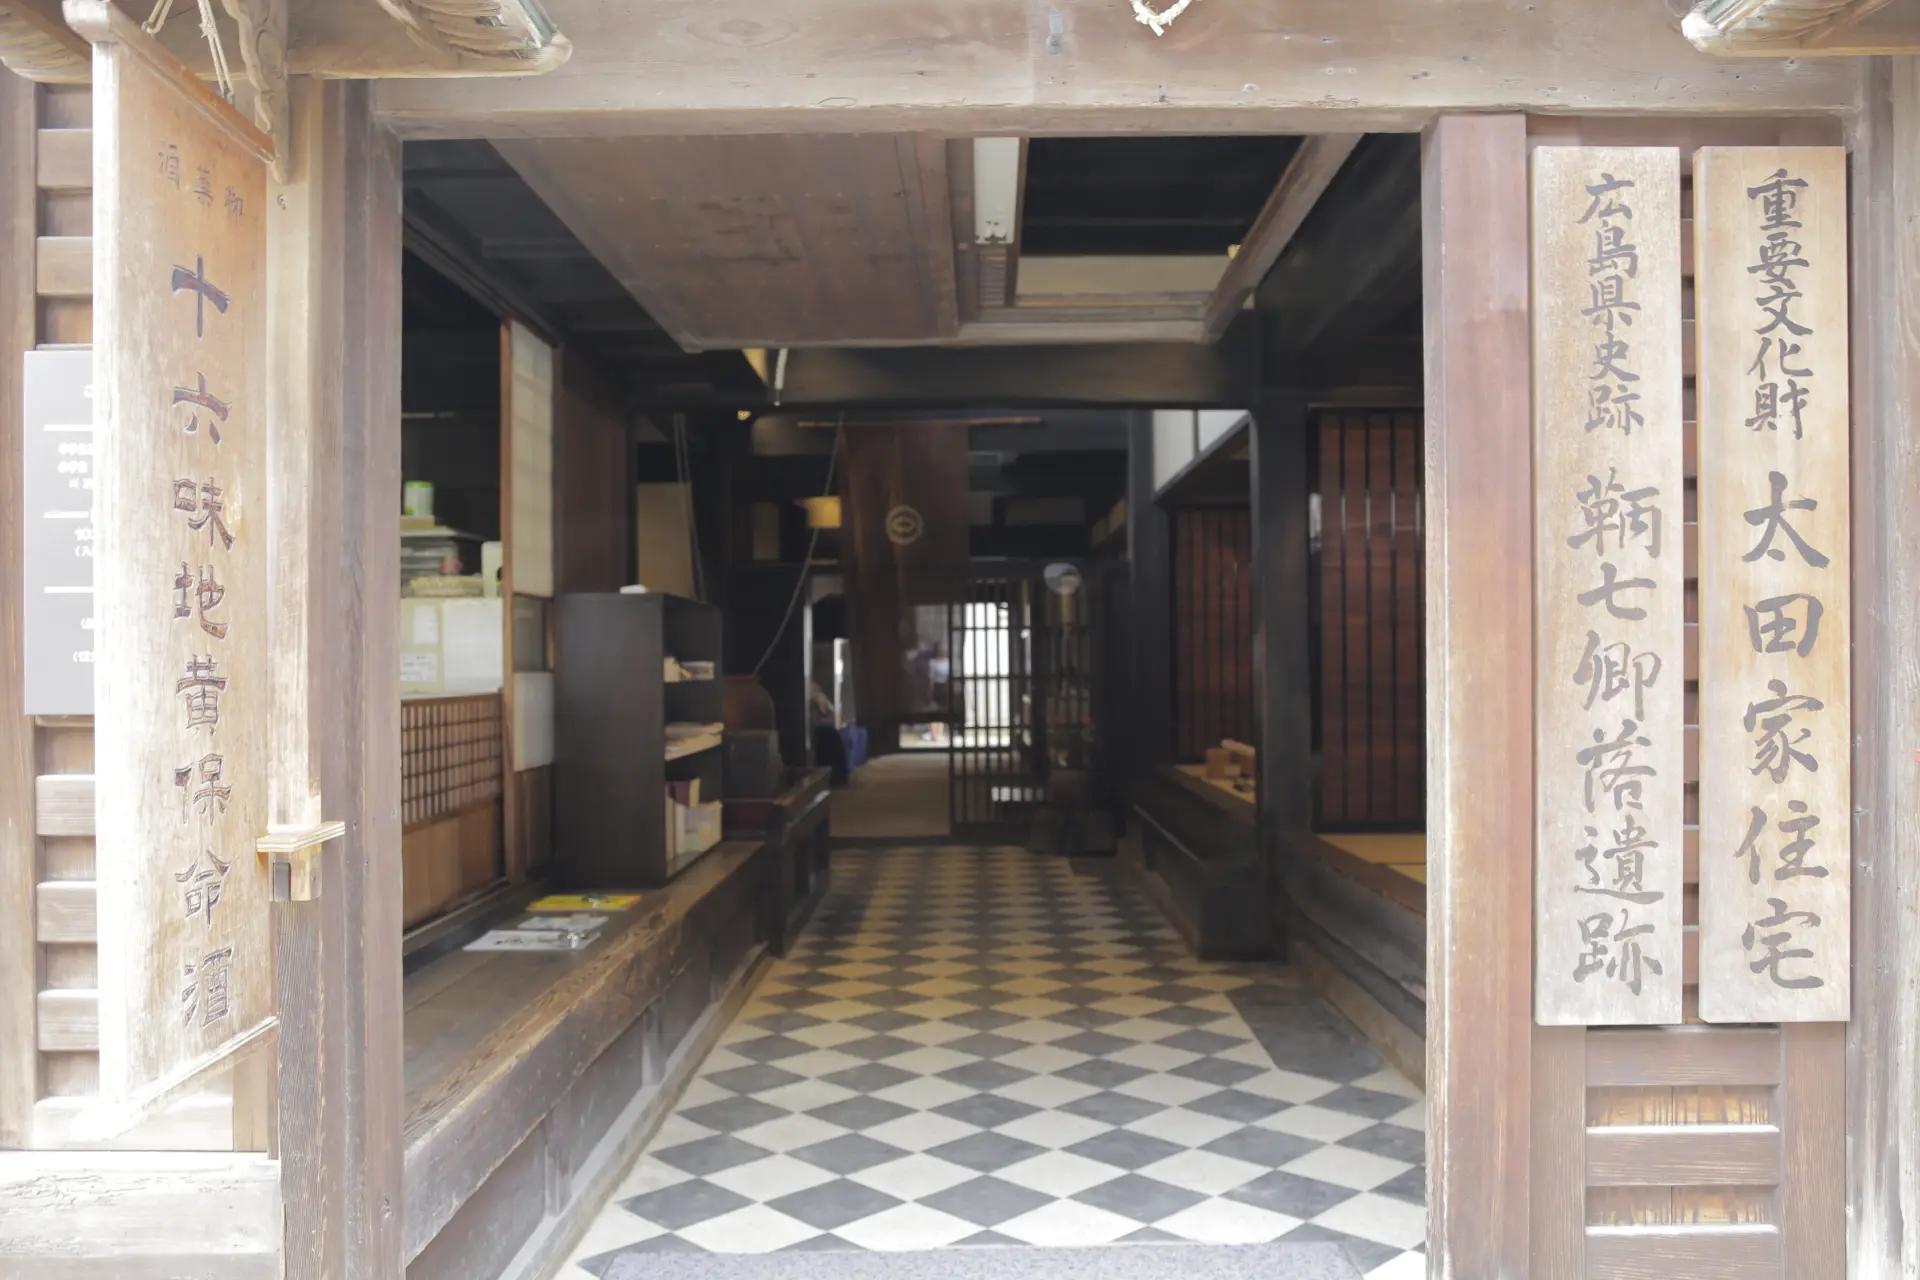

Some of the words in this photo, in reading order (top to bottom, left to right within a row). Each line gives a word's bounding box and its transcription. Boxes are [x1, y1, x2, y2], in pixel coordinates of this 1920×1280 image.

[1577, 173, 1645, 437] 広島県史跡
[1745, 168, 1814, 441] 重要文化財
[1567, 467, 1664, 997] 鞆七卿落遺跡
[1733, 470, 1831, 990] 太田家住宅
